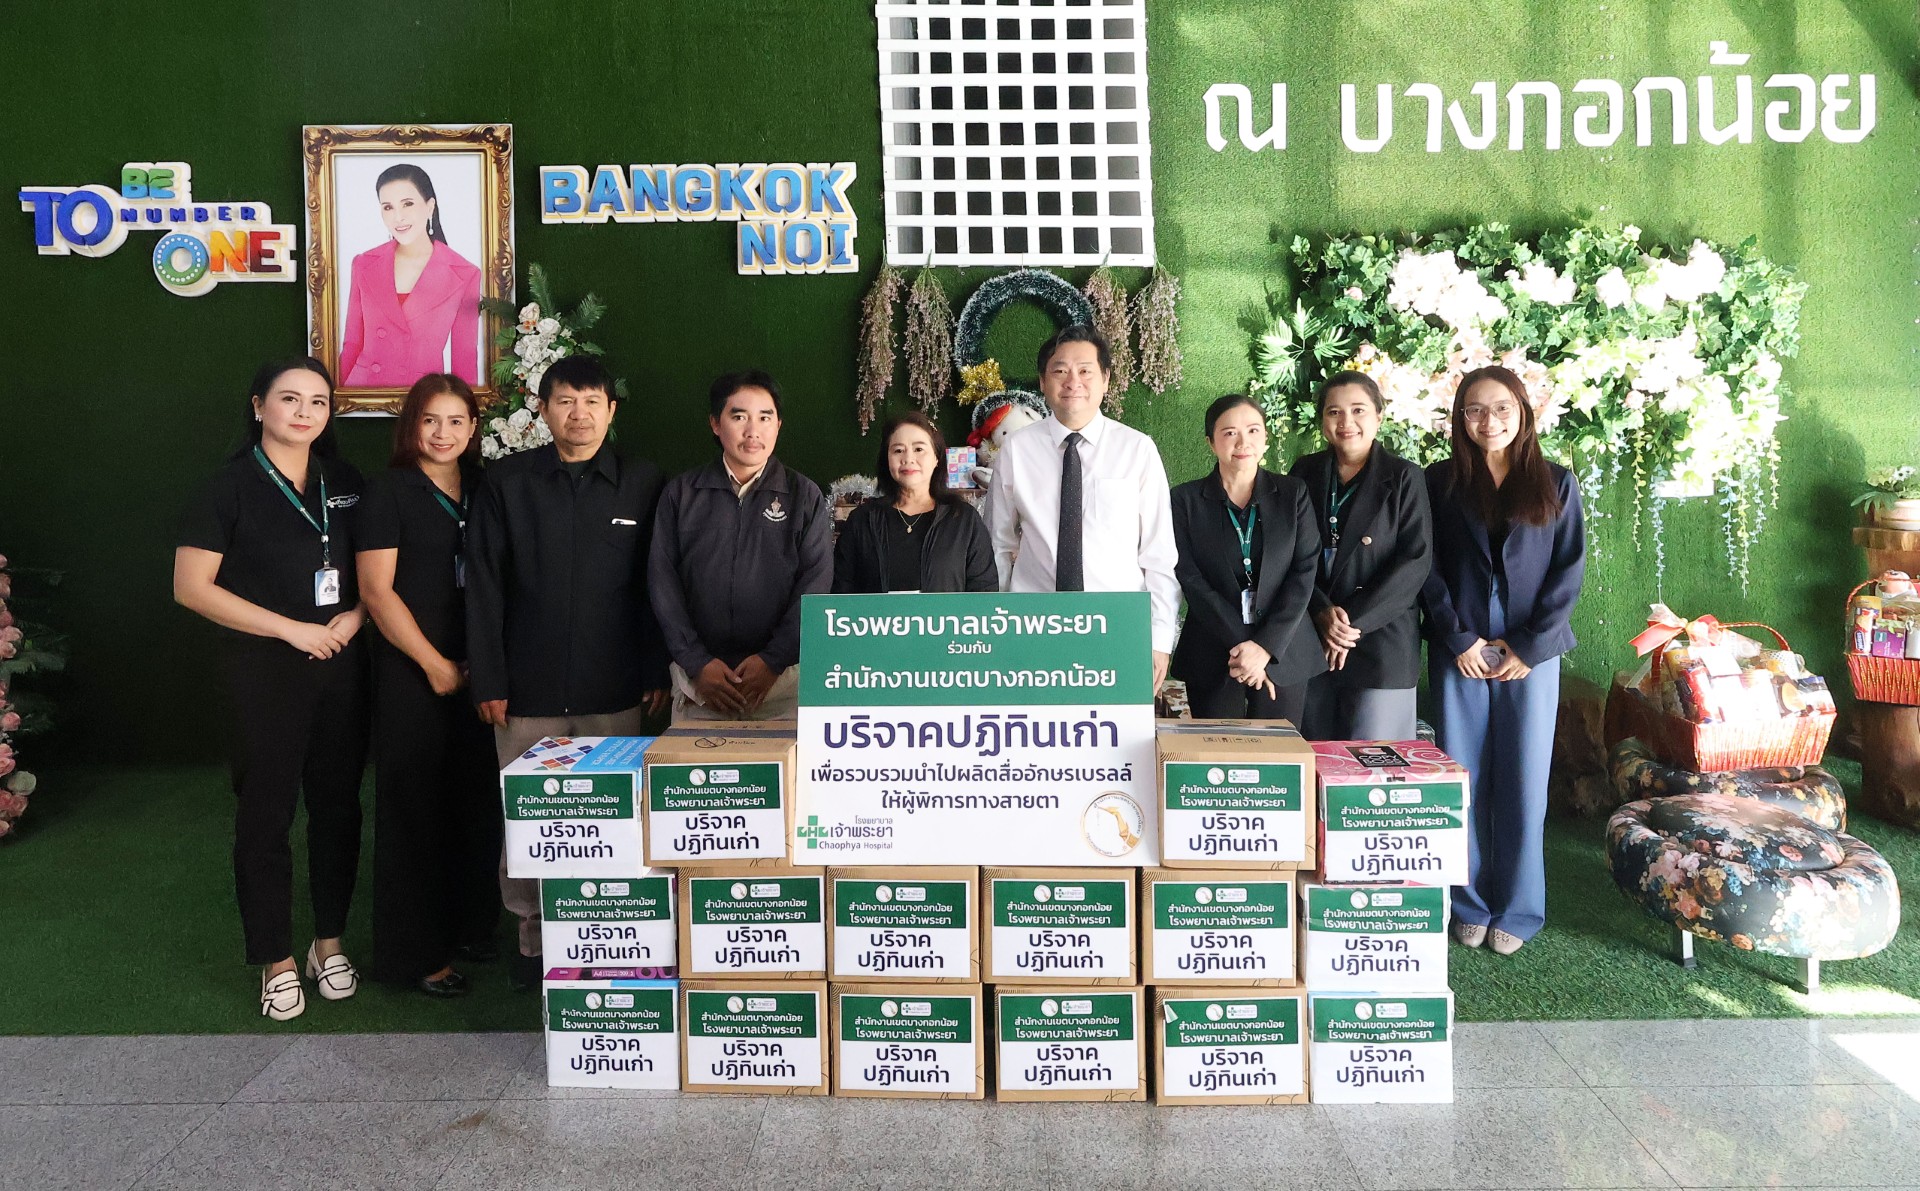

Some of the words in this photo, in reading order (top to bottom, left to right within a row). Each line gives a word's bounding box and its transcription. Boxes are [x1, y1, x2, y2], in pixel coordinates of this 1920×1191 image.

[1202, 81, 1287, 153] ณ
[1340, 41, 1876, 153] บางกอกน้อย
[121, 167, 177, 200] BE
[543, 168, 845, 214] BANGKOK
[18, 190, 115, 248] TO
[120, 206, 259, 223] NUMBER
[740, 223, 852, 266] NOI
[156, 230, 284, 286] ONE
[824, 607, 1108, 638] โรงพยาบาลเจ้าพระยา
[947, 640, 992, 655] ร่วมกับ
[824, 663, 1117, 689] สำนักงานเขตบางกอกน้อย
[823, 711, 1119, 757] บริจาคปฏิทินเก่า
[811, 759, 1133, 783] เพื่อรวบรวมนำไปผลิตสื่ออักษรเบรลล์
[663, 784, 766, 794] สำนักงานเขตบางกอกน้อย
[1180, 784, 1287, 795] สำนักงานเขตบางกอกน้อย
[517, 795, 619, 804] สำนักงานเขตบางกอกน้อย
[665, 796, 766, 808] โรงพยาบาลเจ้าพระยา
[881, 789, 1060, 815] ให้ผู้พิการทางสายตา
[1181, 796, 1286, 808] โรงพยาบาลเจ้าพระยา
[518, 806, 618, 817] โรงพยาบาลเจ้าพระยา
[1341, 805, 1450, 815] สำนักงานเขตบางกอกน้อย
[540, 821, 599, 838] บริจาค
[685, 813, 746, 830] บริจาค
[830, 822, 893, 838] เจ้าพระยา
[1202, 813, 1265, 830] บริจาค
[1342, 816, 1449, 828] โรงพยาบาลเจ้าพระยา
[674, 832, 760, 855] ปฏิทินเก่า
[818, 841, 861, 852] Chaophya
[863, 842, 893, 851] Hospital
[1189, 833, 1278, 855] ปฏิทินเก่า
[1365, 833, 1428, 850] บริจาค
[529, 841, 613, 862] ปฏิทินเก่า
[1351, 854, 1442, 875] ปฏิทินเก่า
[555, 898, 656, 907] สำนักงานเขตบางกอกน้อย
[705, 898, 807, 908] สำนักงานเขตบางกอกน้อย
[849, 902, 953, 912] สำนักงานเขตบางกอกน้อย
[1007, 902, 1112, 912] สำนักงานเขตบางกอกน้อย
[1168, 903, 1274, 913] สำนักงานเขตบางกอกน้อย
[556, 908, 656, 919] โรงพยาบาลเจ้าพระยา
[706, 910, 806, 921] โรงพยาบาลเจ้าพระยา
[850, 912, 951, 924] โรงพยาบาลเจ้าพระยา
[1008, 912, 1111, 924] โรงพยาบาลเจ้าพระยา
[1169, 914, 1273, 926] โรงพยาบาลเจ้าพระยา
[1323, 908, 1430, 918] สำนักงานเขตบางกอกน้อย
[578, 924, 637, 940] บริจาค
[1324, 918, 1428, 930] โรงพยาบาลเจ้าพระยา
[727, 926, 787, 943] บริจาค
[871, 930, 931, 947] บริจาค
[1029, 930, 1090, 947] บริจาค
[1191, 932, 1252, 949] บริจาค
[567, 942, 650, 963] ปฏิทินเก่า
[1345, 936, 1408, 952] บริจาค
[715, 945, 800, 967] ปฏิทินเก่า
[858, 951, 944, 972] ปฏิทินเก่า
[1016, 950, 1104, 972] ปฏิทินเก่า
[1178, 952, 1266, 973] ปฏิทินเก่า
[1331, 955, 1420, 975] ปฏิทินเก่า
[561, 1008, 660, 1018] สำนักงานเขตบางกอกน้อย
[701, 1012, 803, 1022] สำนักงานเขตบางกอกน้อย
[855, 1016, 958, 1027] สำนักงานเขตบางกอกน้อย
[1015, 1015, 1120, 1025] สำนักงานเขตบางกอกน้อย
[562, 1019, 659, 1030] โรงพยาบาลเจ้าพระยา
[703, 1023, 802, 1034] โรงพยาบาลเจ้าพระยา
[1016, 1027, 1119, 1038] โรงพยาบาลเจ้าพระยา
[1179, 1019, 1285, 1030] สำนักงานเขตบางกอกน้อย
[1328, 1019, 1434, 1029] สำนักงานเขตบางกอกน้อย
[856, 1028, 956, 1040] โรงพยาบาลเจ้าพระยา
[1180, 1031, 1284, 1043] โรงพยาบาลเจ้าพระยา
[1329, 1029, 1432, 1040] โรงพยาบาลเจ้าพระยา
[582, 1035, 640, 1051] บริจาค
[723, 1040, 783, 1056] บริจาค
[876, 1044, 937, 1062] บริจาค
[1037, 1044, 1098, 1061] บริจาค
[1202, 1049, 1263, 1066] บริจาค
[1350, 1045, 1412, 1062] บริจาค
[570, 1054, 653, 1074] ปฏิทินเก่า
[711, 1059, 796, 1080] ปฏิทินเก่า
[864, 1065, 950, 1085] ปฏิทินเก่า
[1024, 1063, 1112, 1085] ปฏิทินเก่า
[1189, 1068, 1277, 1090] ปฏิทินเก่า
[1336, 1066, 1425, 1086] ปฏิทินเก่า
